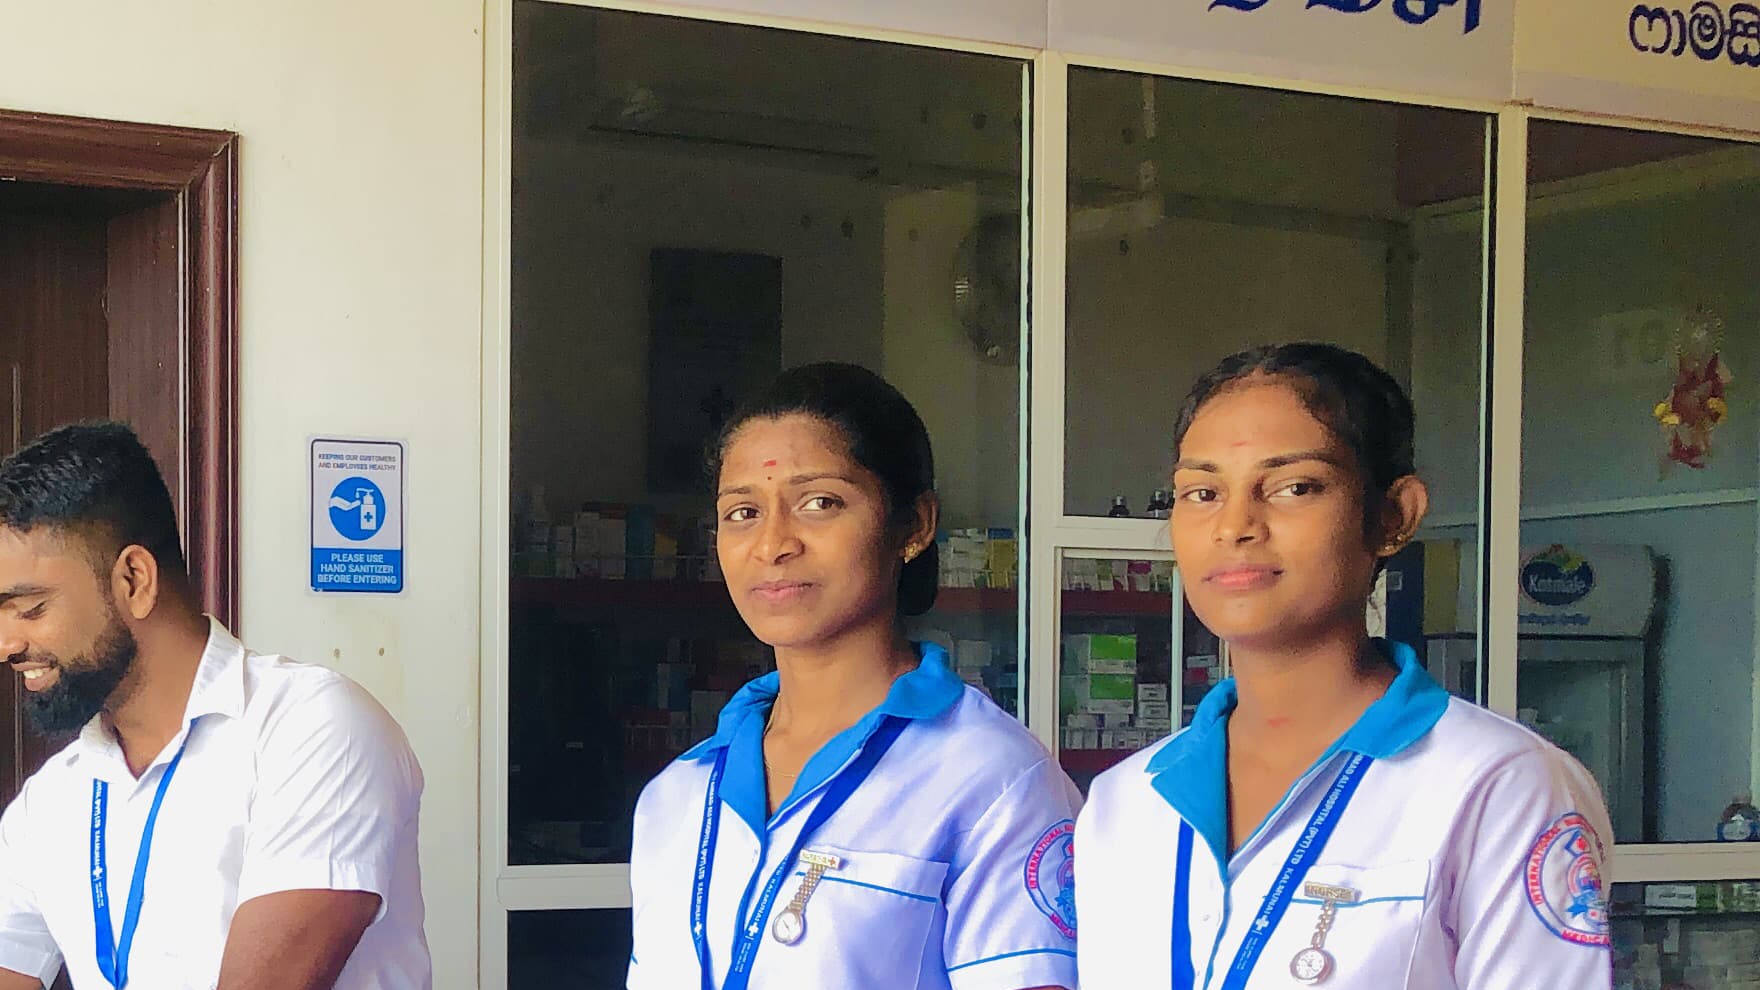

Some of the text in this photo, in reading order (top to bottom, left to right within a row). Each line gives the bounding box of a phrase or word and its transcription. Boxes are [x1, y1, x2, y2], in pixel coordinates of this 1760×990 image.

[331, 553, 384, 563] PLEASE USE
[320, 564, 394, 574] HAND SANITIZER
[317, 574, 397, 584] BEFORE ENTERING
[1313, 788, 1342, 828] HOSPITAL
[1291, 849, 1306, 865] LTD
[1264, 867, 1294, 915] KALMUNAI
